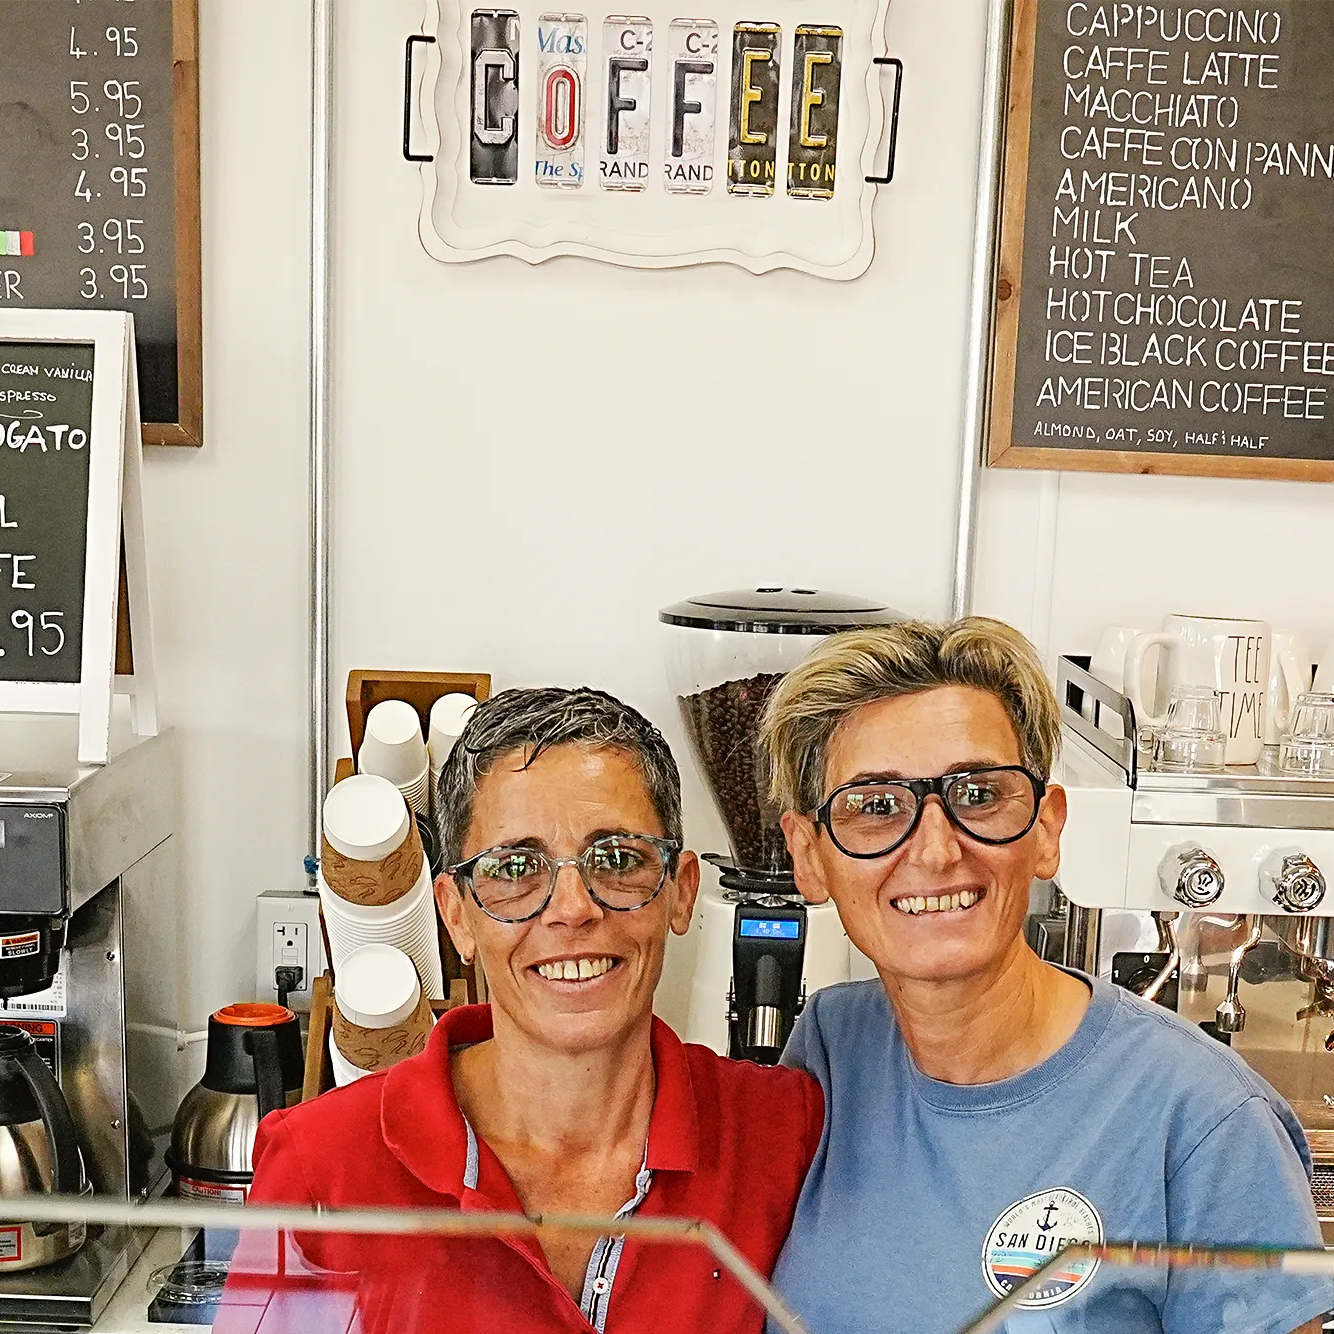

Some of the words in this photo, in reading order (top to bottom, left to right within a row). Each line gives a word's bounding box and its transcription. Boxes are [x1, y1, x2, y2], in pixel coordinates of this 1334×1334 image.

[69, 26, 139, 59] 4.95
[1066, 2, 1281, 44] CAPPUCCINO
[1063, 45, 1170, 85] CAFFE
[1182, 51, 1280, 89] LATTE
[70, 79, 142, 119] 5.95
[1064, 82, 1239, 128] MACCHIATO
[71, 122, 145, 161] 3.95
[1060, 125, 1165, 166] CAFFE
[1169, 137, 1237, 172] CON
[74, 166, 148, 203] 4.95
[1054, 168, 1252, 211] AMERICANO
[77, 218, 145, 254] 3.95
[1052, 205, 1139, 245] MILK
[79, 264, 148, 299] 3.95
[1049, 245, 1116, 283] HOT
[1128, 252, 1194, 289] TEA
[1045, 329, 1094, 364] ICE
[1100, 332, 1207, 367] BLACK
[1035, 375, 1193, 412] AMERICAN
[1199, 380, 1327, 420] COFFEE
[1033, 420, 1100, 444] ALMOND,
[1105, 427, 1142, 446] OAT,
[1146, 428, 1178, 448] SOY,
[1185, 431, 1219, 445] HALF
[1230, 434, 1270, 450] HALF
[1227, 635, 1260, 684] TEE
[1218, 691, 1264, 739] TIME
[8, 948, 34, 956] SLOWLY
[995, 1232, 1030, 1249] SAN
